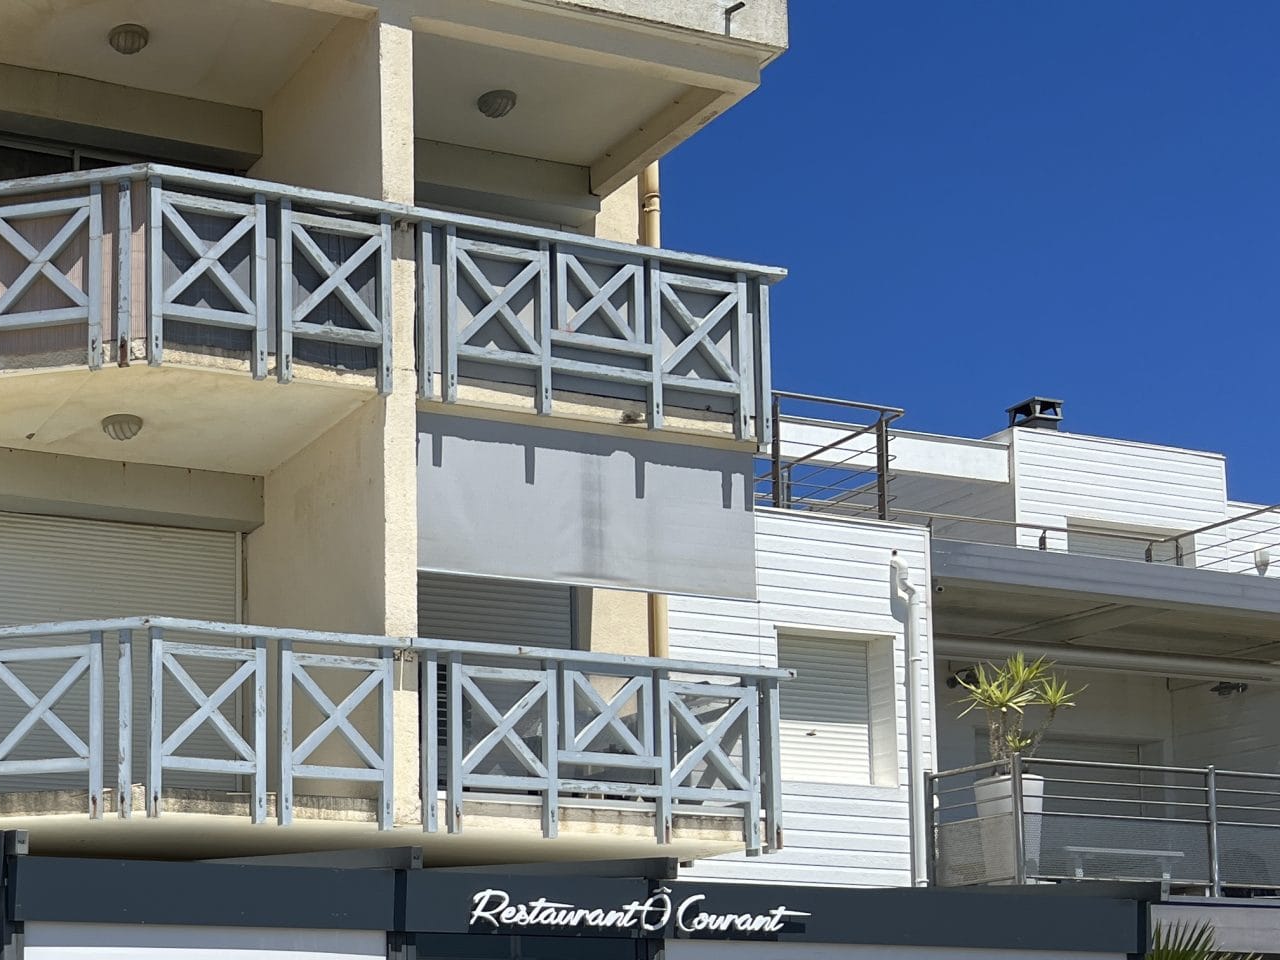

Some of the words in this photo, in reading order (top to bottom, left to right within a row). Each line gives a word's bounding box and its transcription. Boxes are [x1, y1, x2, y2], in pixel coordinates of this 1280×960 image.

[470, 889, 652, 927] Restaurant
[641, 886, 672, 932] Ô
[678, 894, 812, 932] Courant
